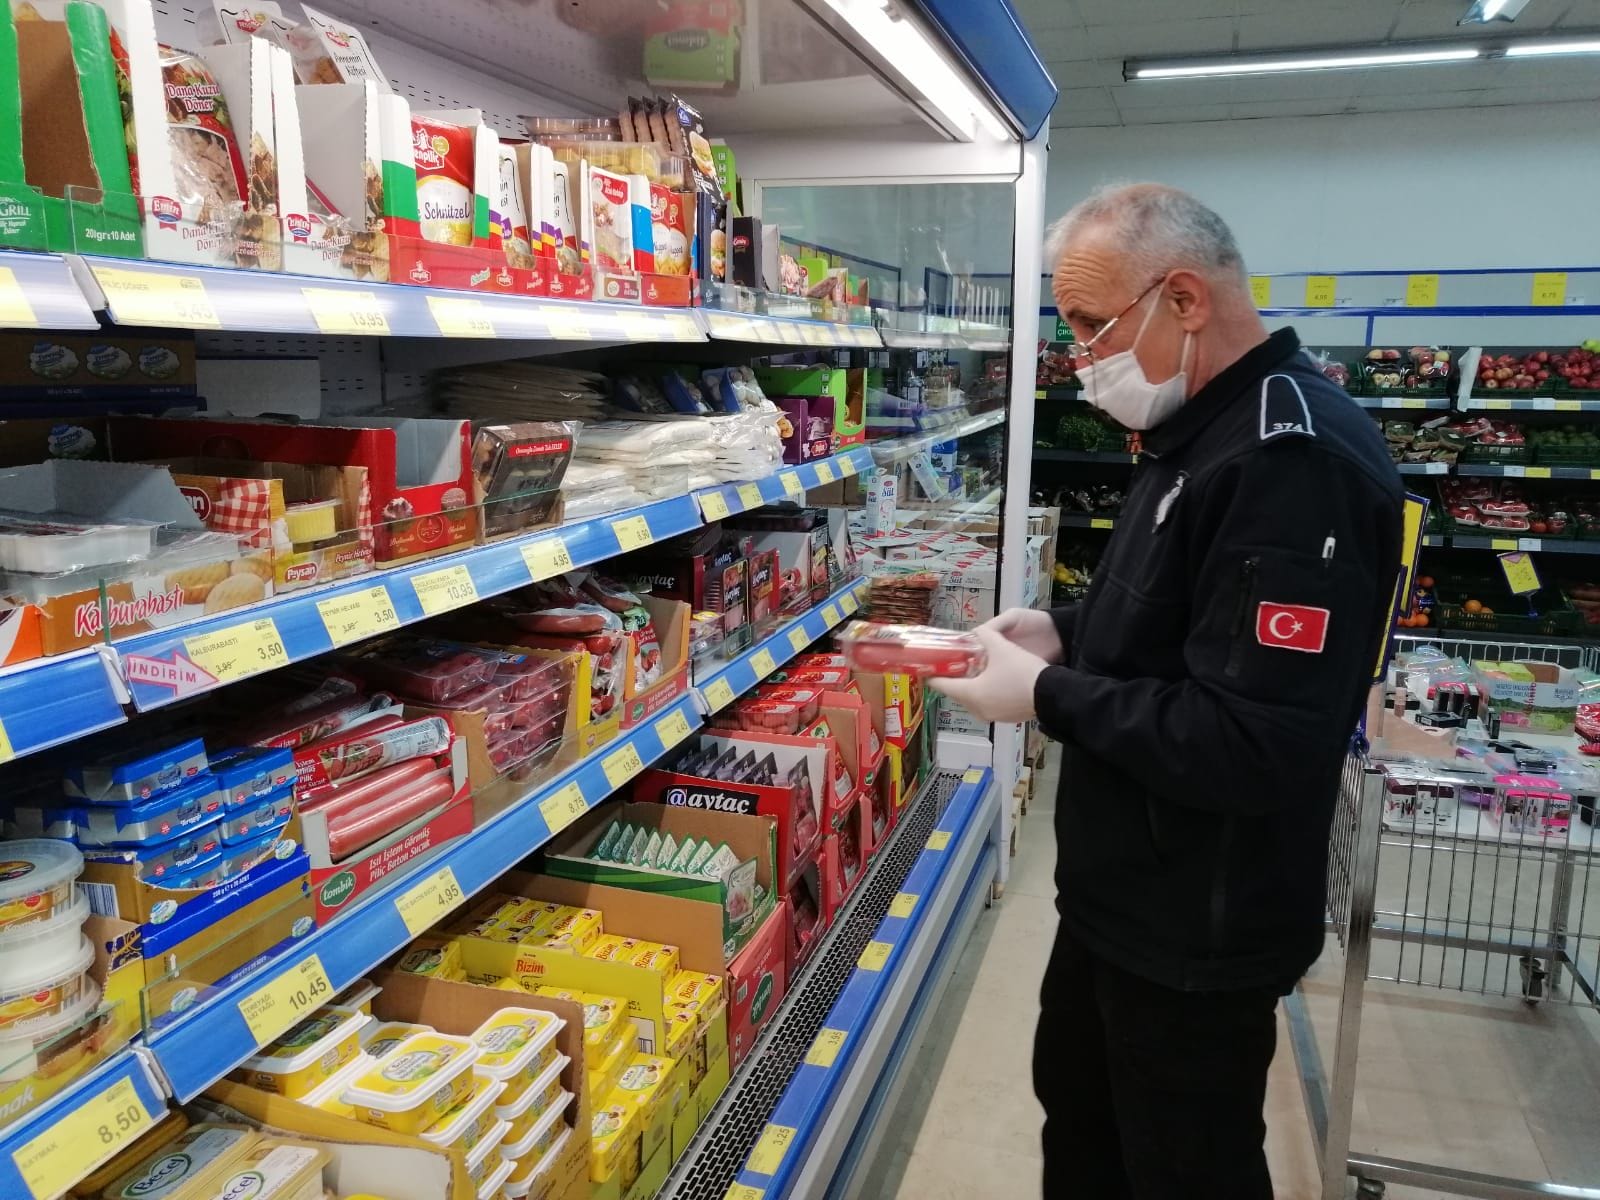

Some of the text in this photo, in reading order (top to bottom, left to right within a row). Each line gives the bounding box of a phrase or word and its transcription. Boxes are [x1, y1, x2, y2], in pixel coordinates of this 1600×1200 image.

[184, 97, 214, 113] Döner
[424, 201, 470, 220] Schnitzel
[1272, 422, 1304, 432] 374
[553, 553, 569, 568] 4,95
[447, 583, 474, 601] 10,95
[75, 583, 185, 637] Kaburabastı
[374, 608, 394, 623] 3,50
[190, 637, 238, 657] KALBURABASTI
[257, 642, 283, 660] 3,50
[133, 661, 197, 683] İNDİRİM
[568, 797, 585, 814] 8,75
[404, 826, 431, 848] Görmüş
[369, 866, 385, 882] Piliç
[409, 839, 431, 858] Sucuk
[323, 876, 353, 901] tombik
[437, 884, 459, 905] 4,95
[515, 959, 545, 974] Bizim
[289, 976, 327, 1010] 10,45
[97, 1105, 142, 1144] 8,50
[773, 1128, 791, 1146] 3,25
[134, 1158, 185, 1191] Becel
[223, 1175, 257, 1200] ecel
